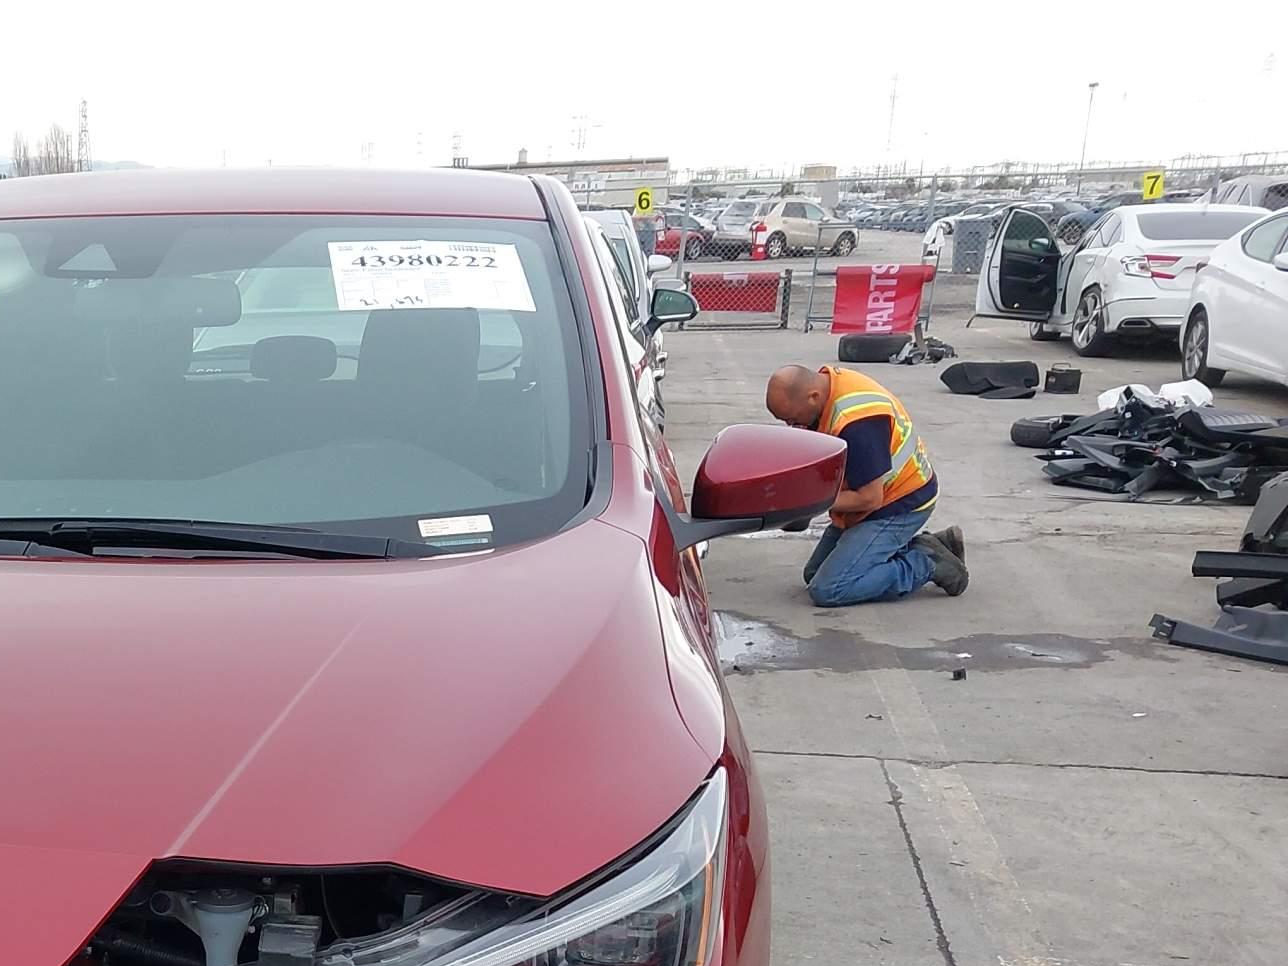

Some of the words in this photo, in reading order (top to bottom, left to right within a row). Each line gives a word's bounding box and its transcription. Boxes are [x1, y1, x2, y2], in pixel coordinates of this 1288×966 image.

[1146, 175, 1161, 195] 7
[638, 191, 650, 210] 6
[351, 254, 498, 268] 43980222
